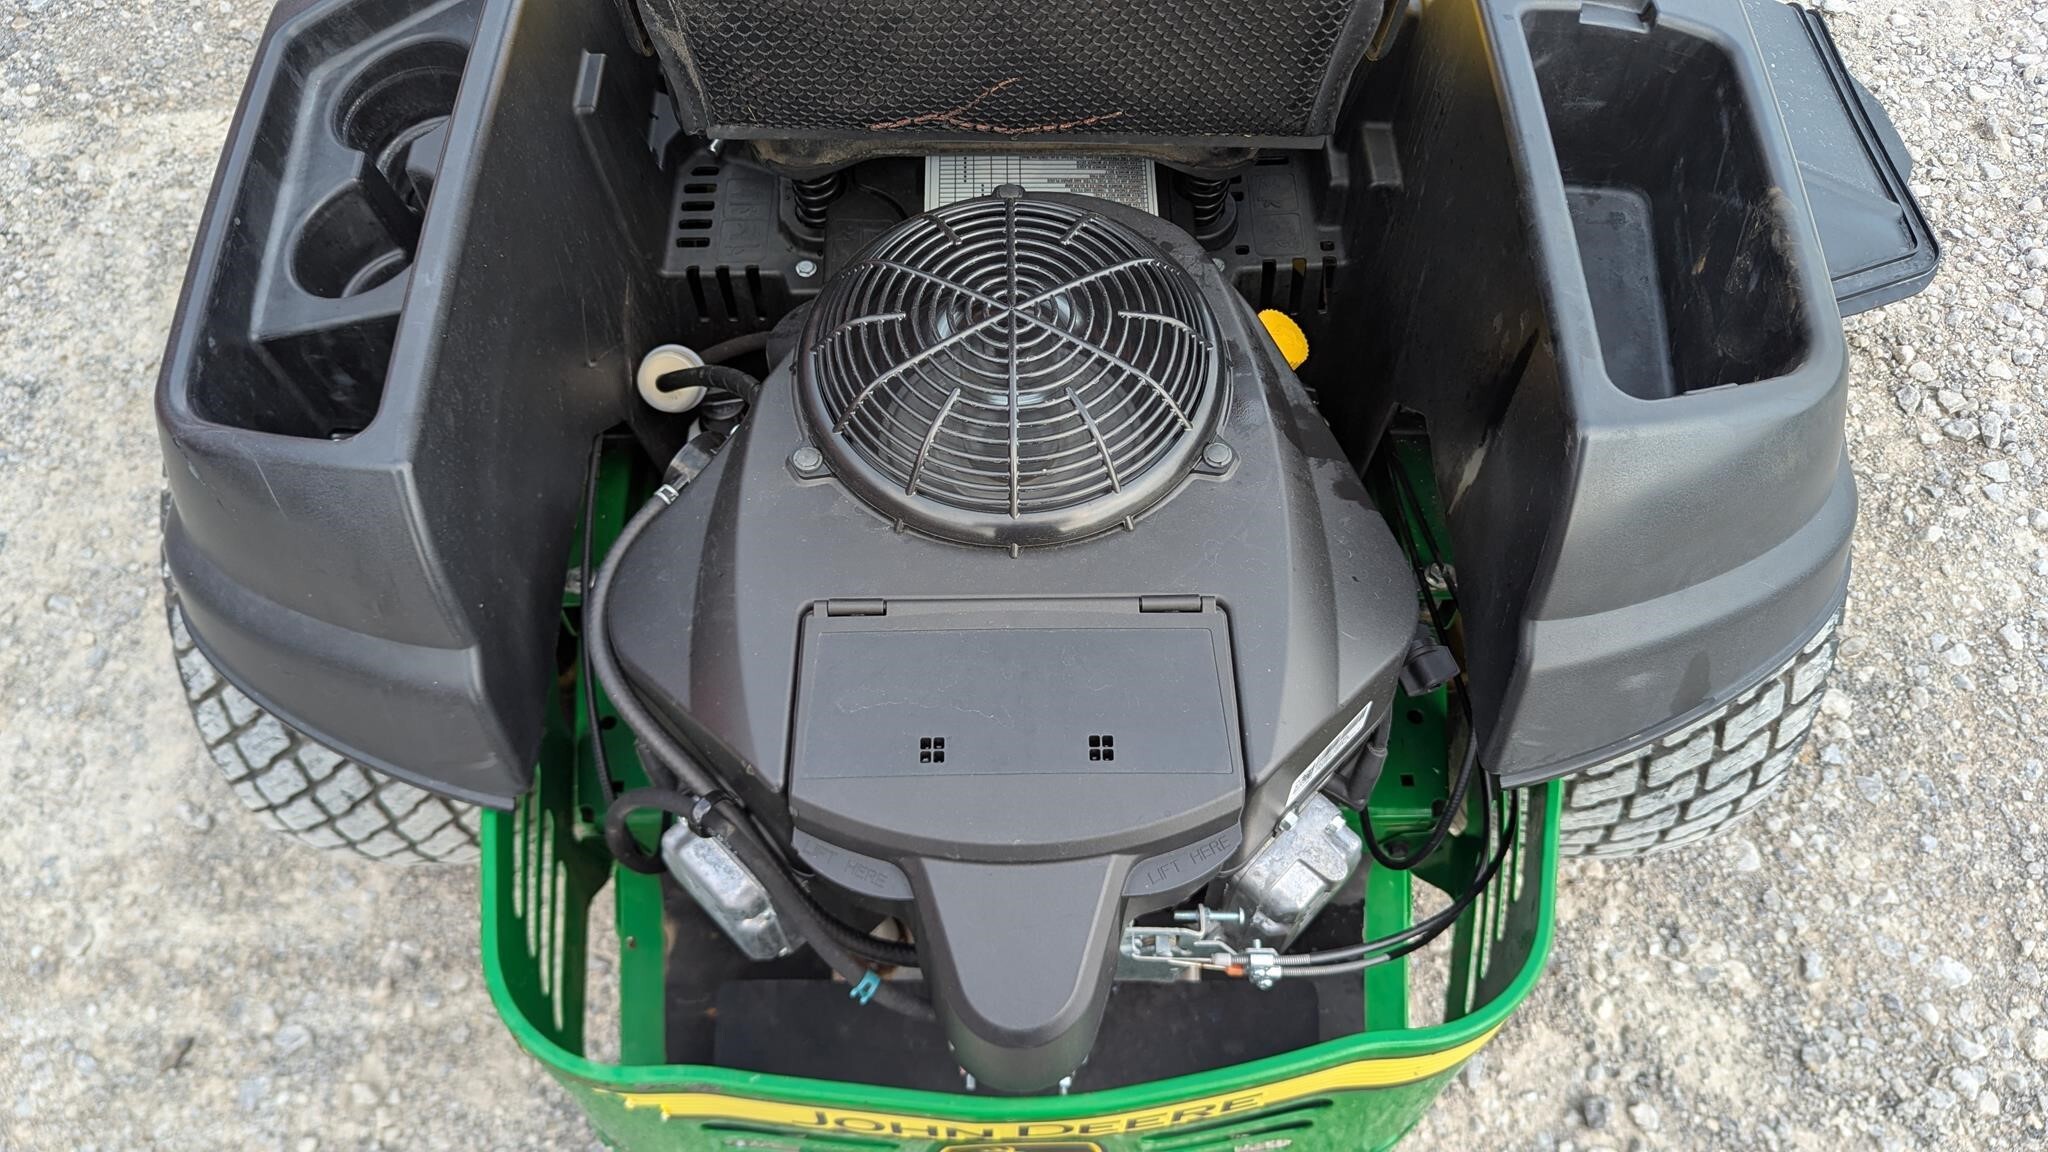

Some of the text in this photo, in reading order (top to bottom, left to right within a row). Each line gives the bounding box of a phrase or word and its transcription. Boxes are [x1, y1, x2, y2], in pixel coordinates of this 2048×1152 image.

[802, 839, 889, 889] LIFT HERE
[1145, 834, 1231, 886] LIFT HERE
[791, 1092, 1264, 1139] JOHN DEERE
